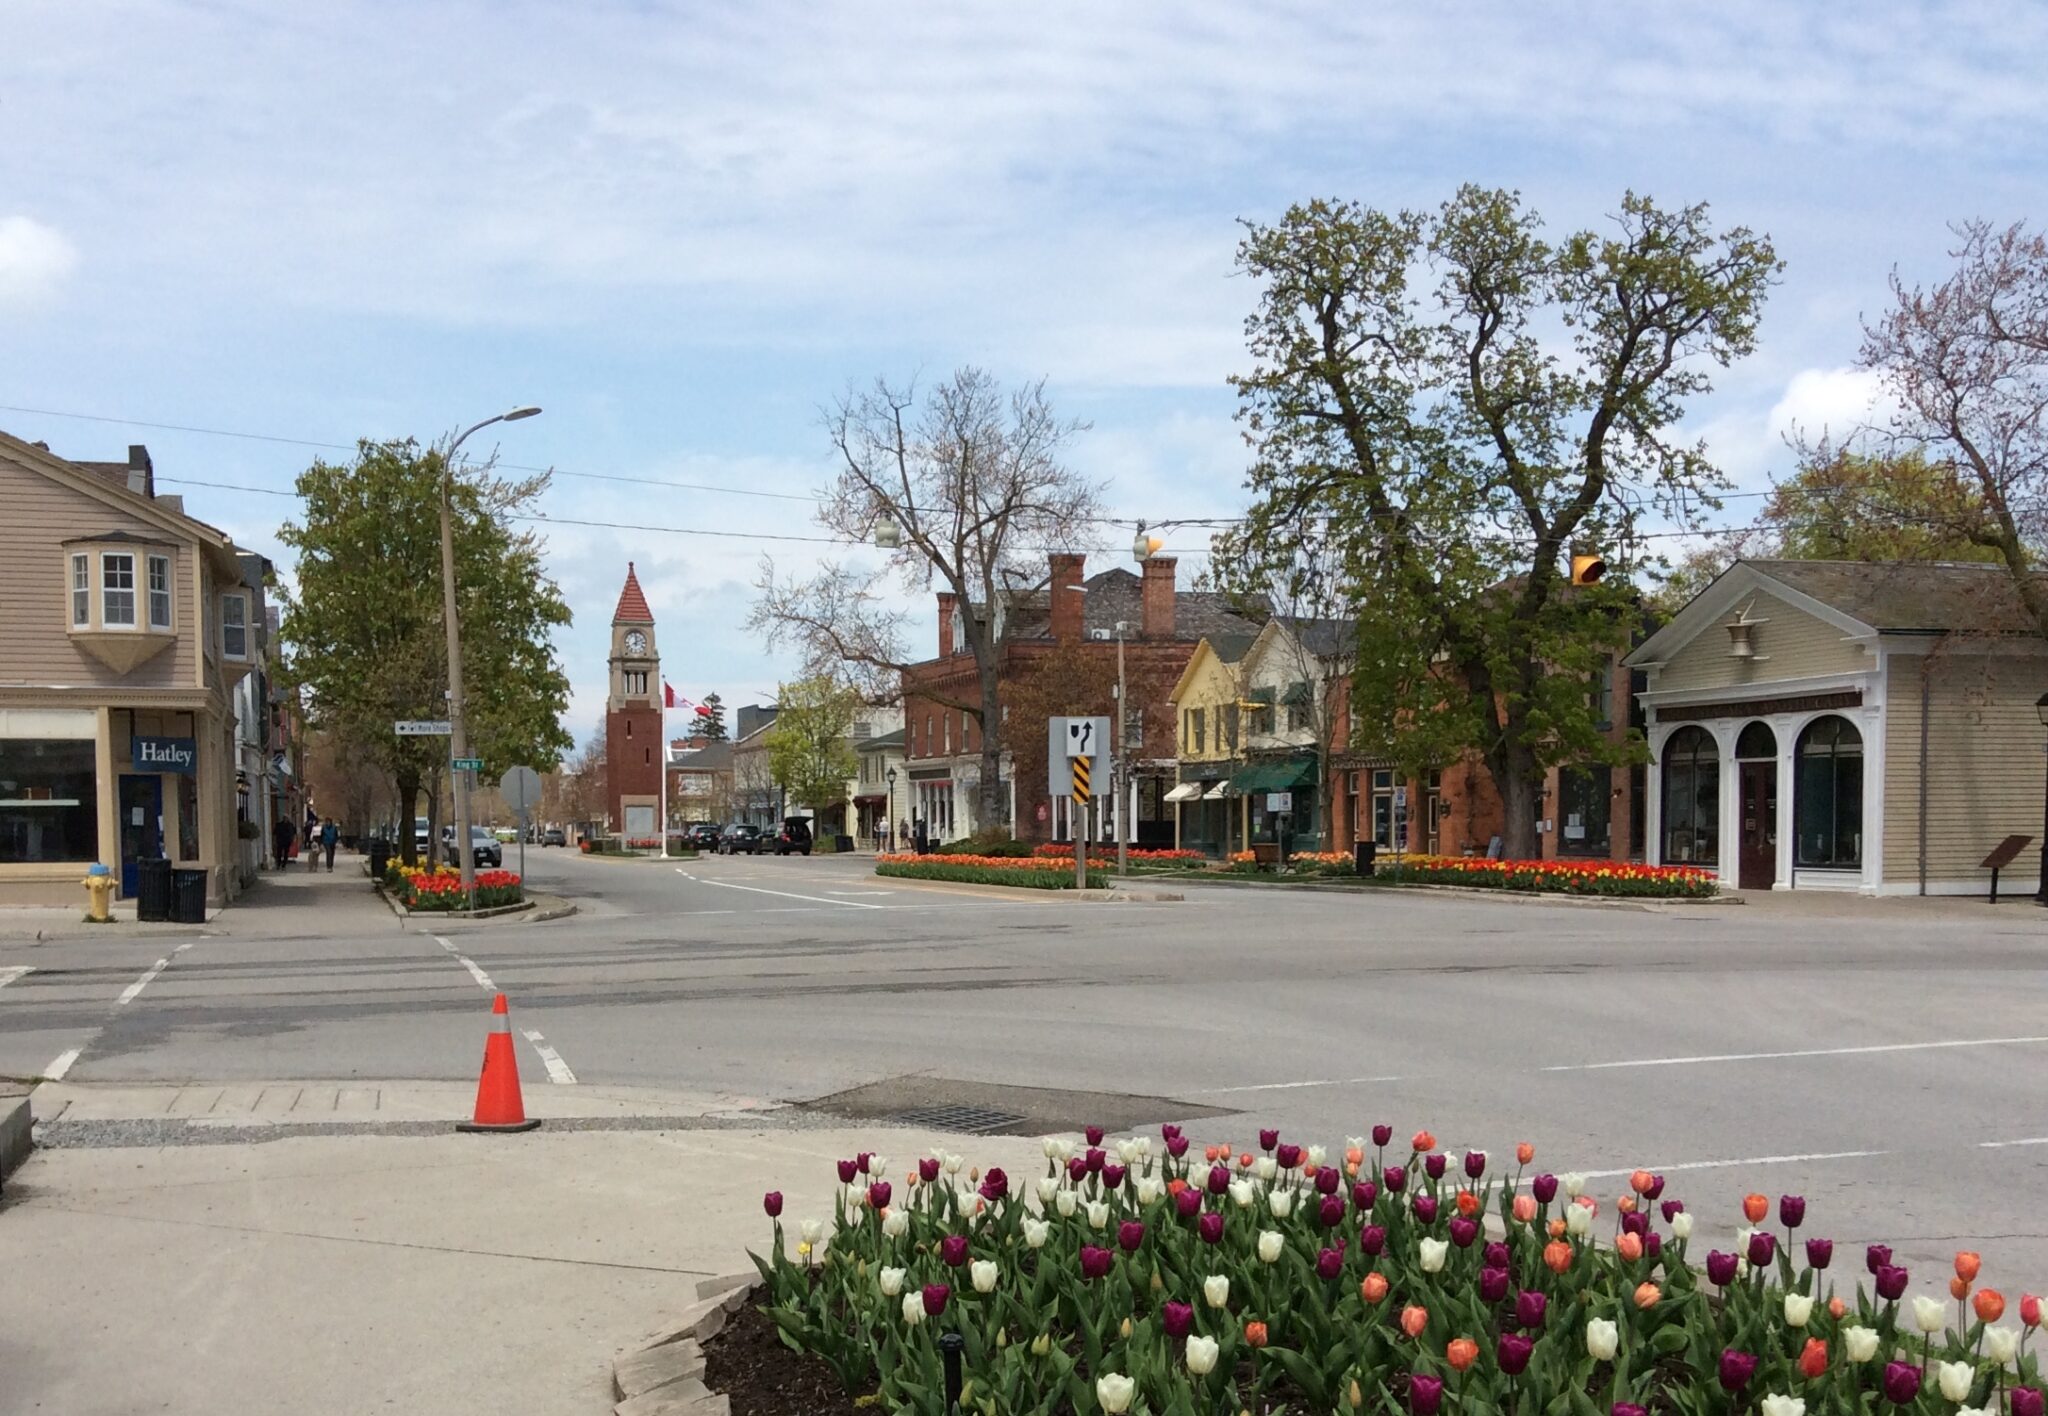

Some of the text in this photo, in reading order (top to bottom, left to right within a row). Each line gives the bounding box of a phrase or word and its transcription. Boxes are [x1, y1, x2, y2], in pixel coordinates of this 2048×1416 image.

[433, 725, 449, 733] Shops
[140, 742, 192, 767] Hatley
[456, 761, 470, 770] King
